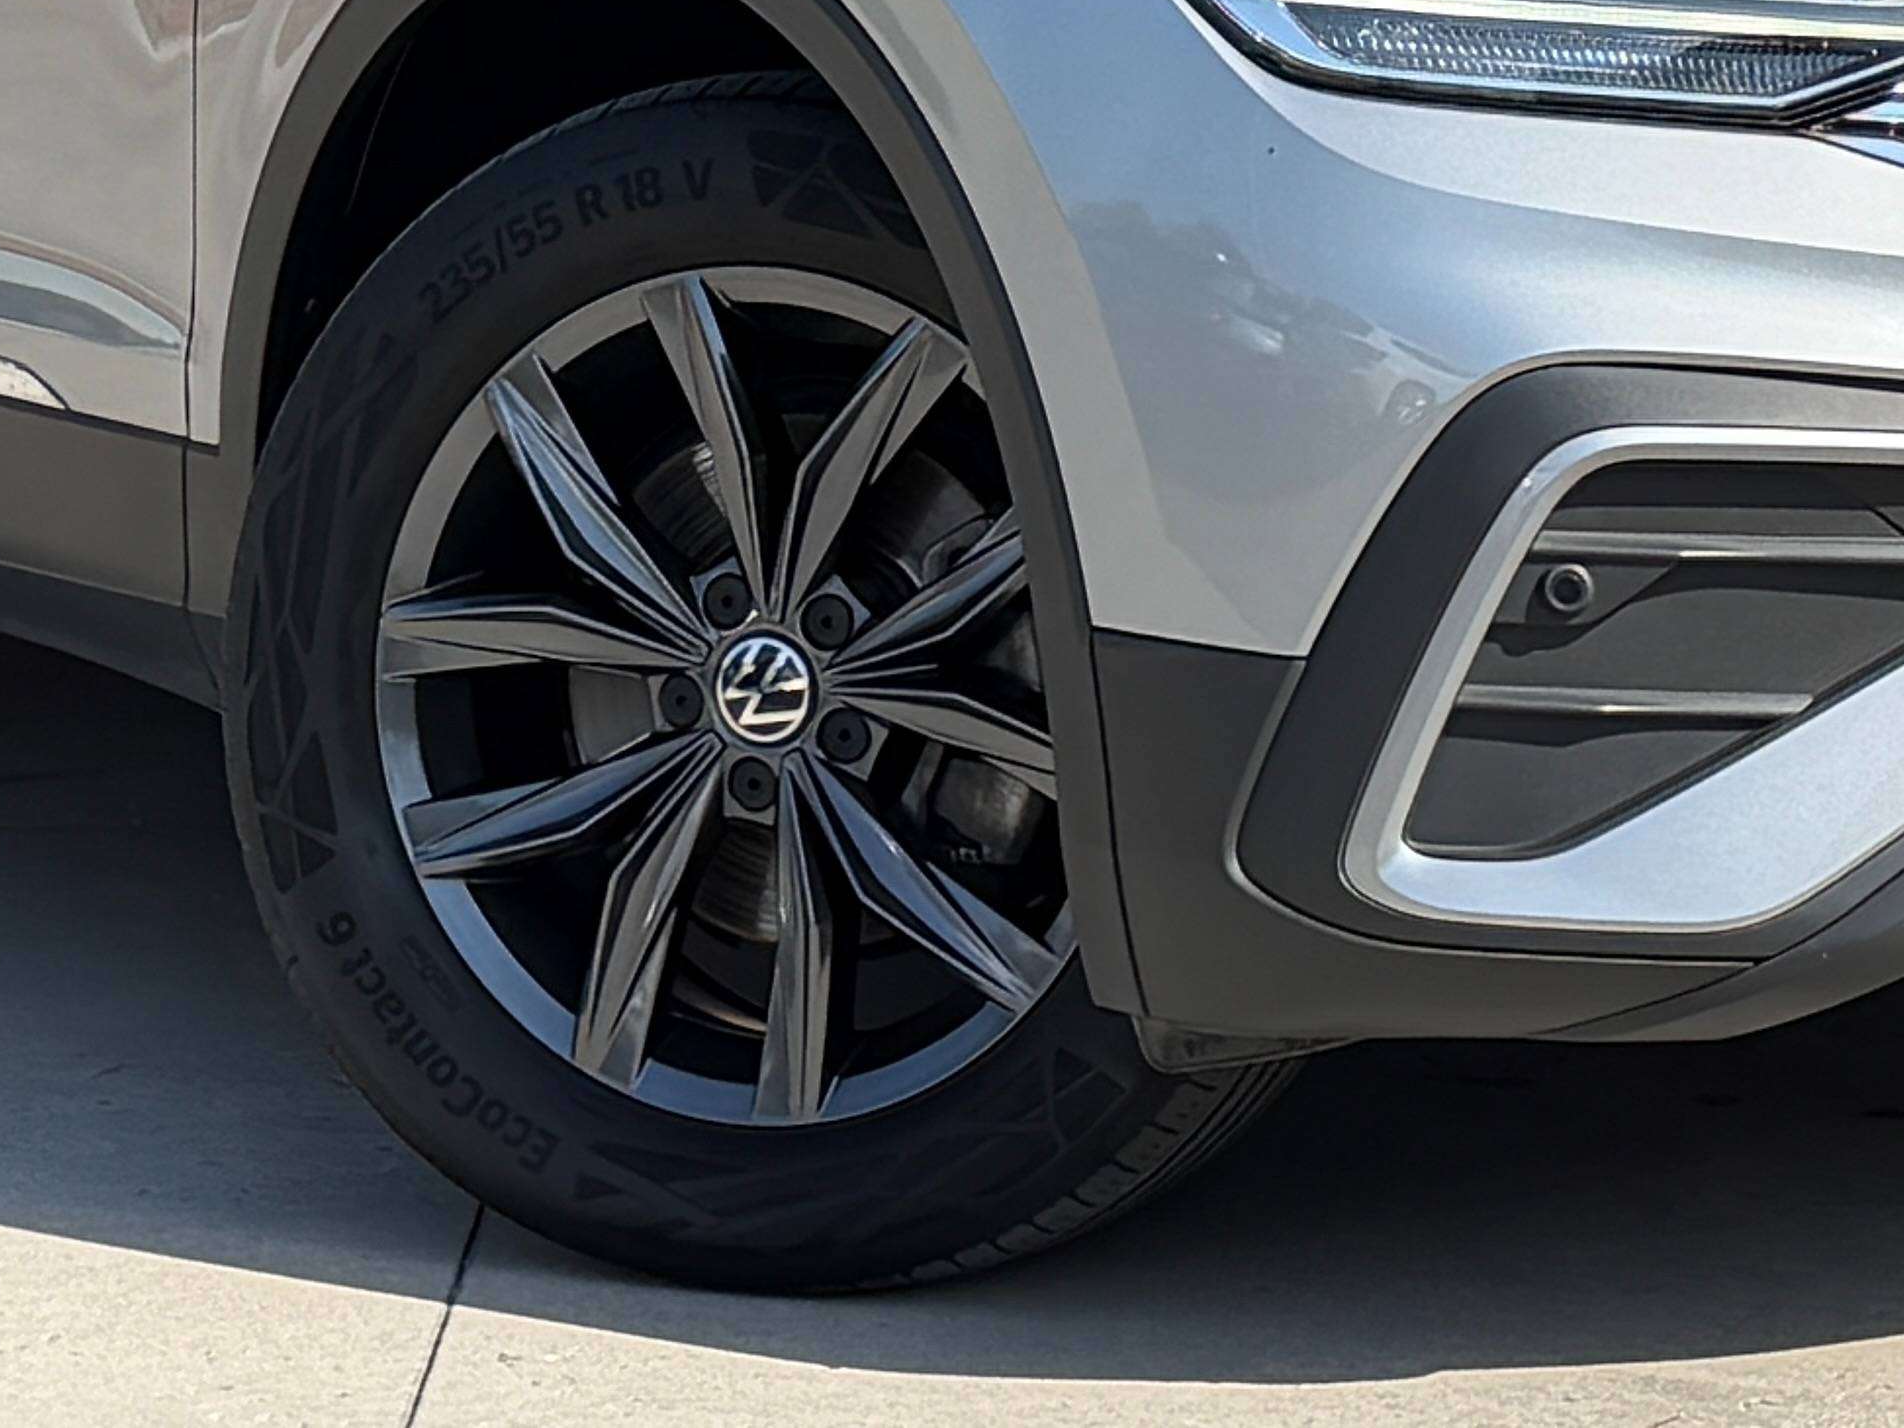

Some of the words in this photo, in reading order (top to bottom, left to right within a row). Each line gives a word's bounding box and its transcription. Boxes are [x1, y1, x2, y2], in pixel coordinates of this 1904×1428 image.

[417, 199, 564, 324] 235/55
[575, 183, 610, 226] R
[621, 165, 665, 212] 18
[681, 156, 714, 201] V
[317, 910, 359, 946] 6
[340, 947, 564, 1174] EcoContact
